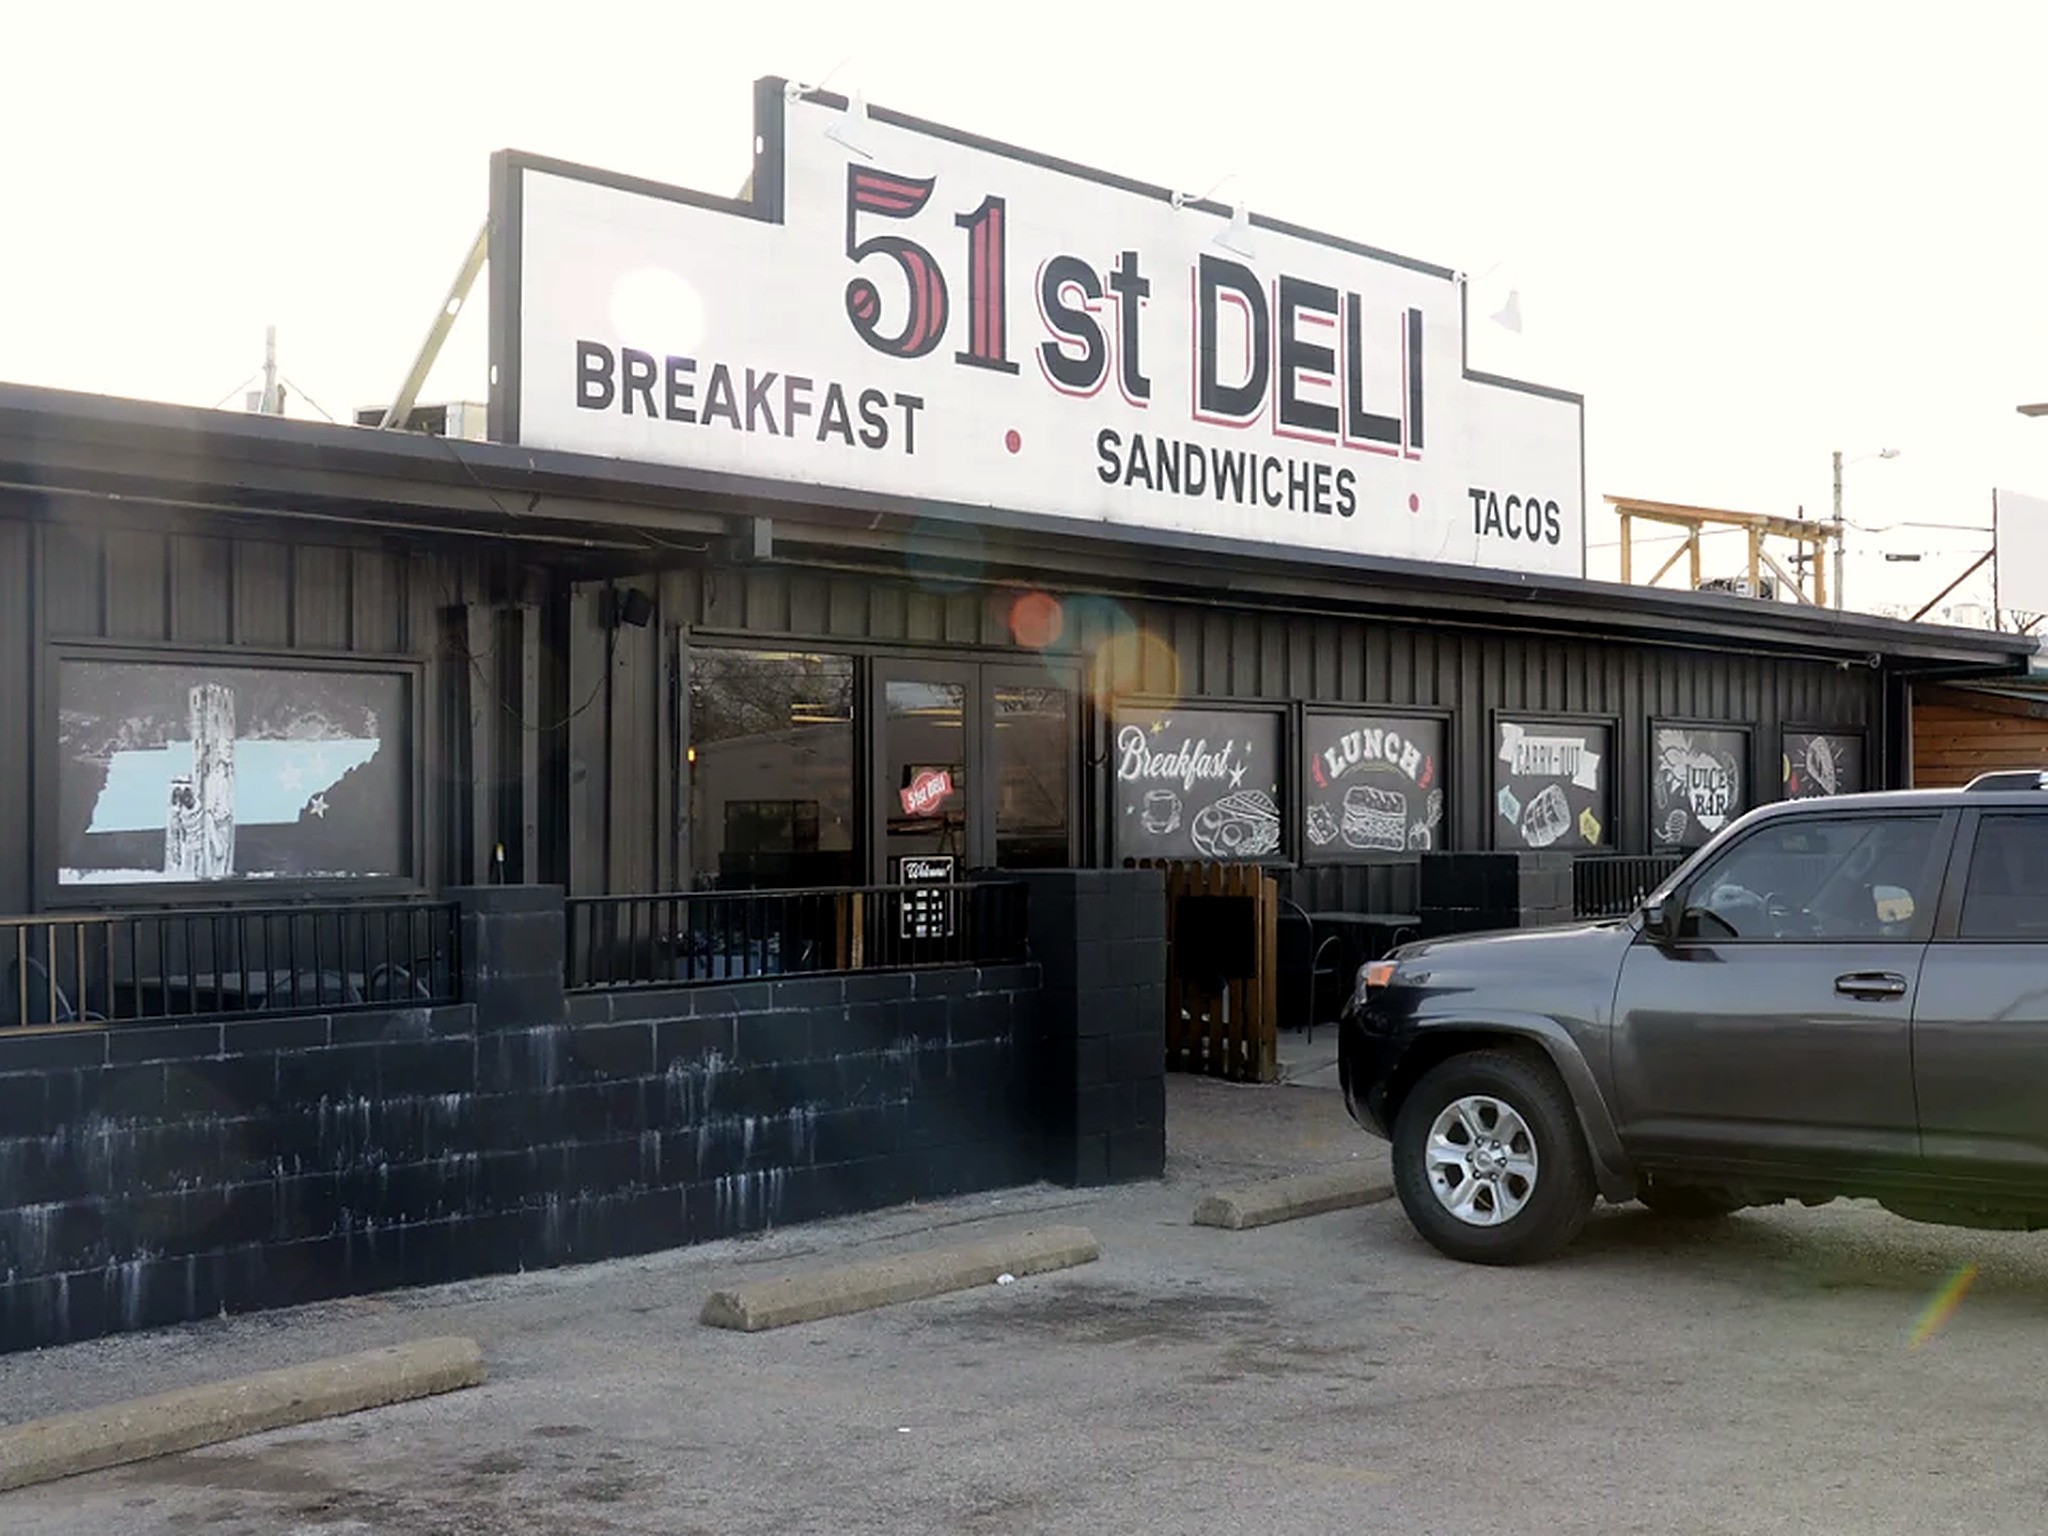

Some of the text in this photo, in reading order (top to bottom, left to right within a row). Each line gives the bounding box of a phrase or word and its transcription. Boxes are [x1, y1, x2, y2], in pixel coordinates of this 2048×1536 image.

[846, 162, 1424, 460] 51st DELI
[576, 340, 1561, 546] BREAKFAST SANDWICHES TACOS
[1118, 725, 1234, 791] Breakfast
[1324, 728, 1421, 780] LUNCH
[1684, 764, 1728, 793] JUICE
[1695, 794, 1727, 816] BAR
